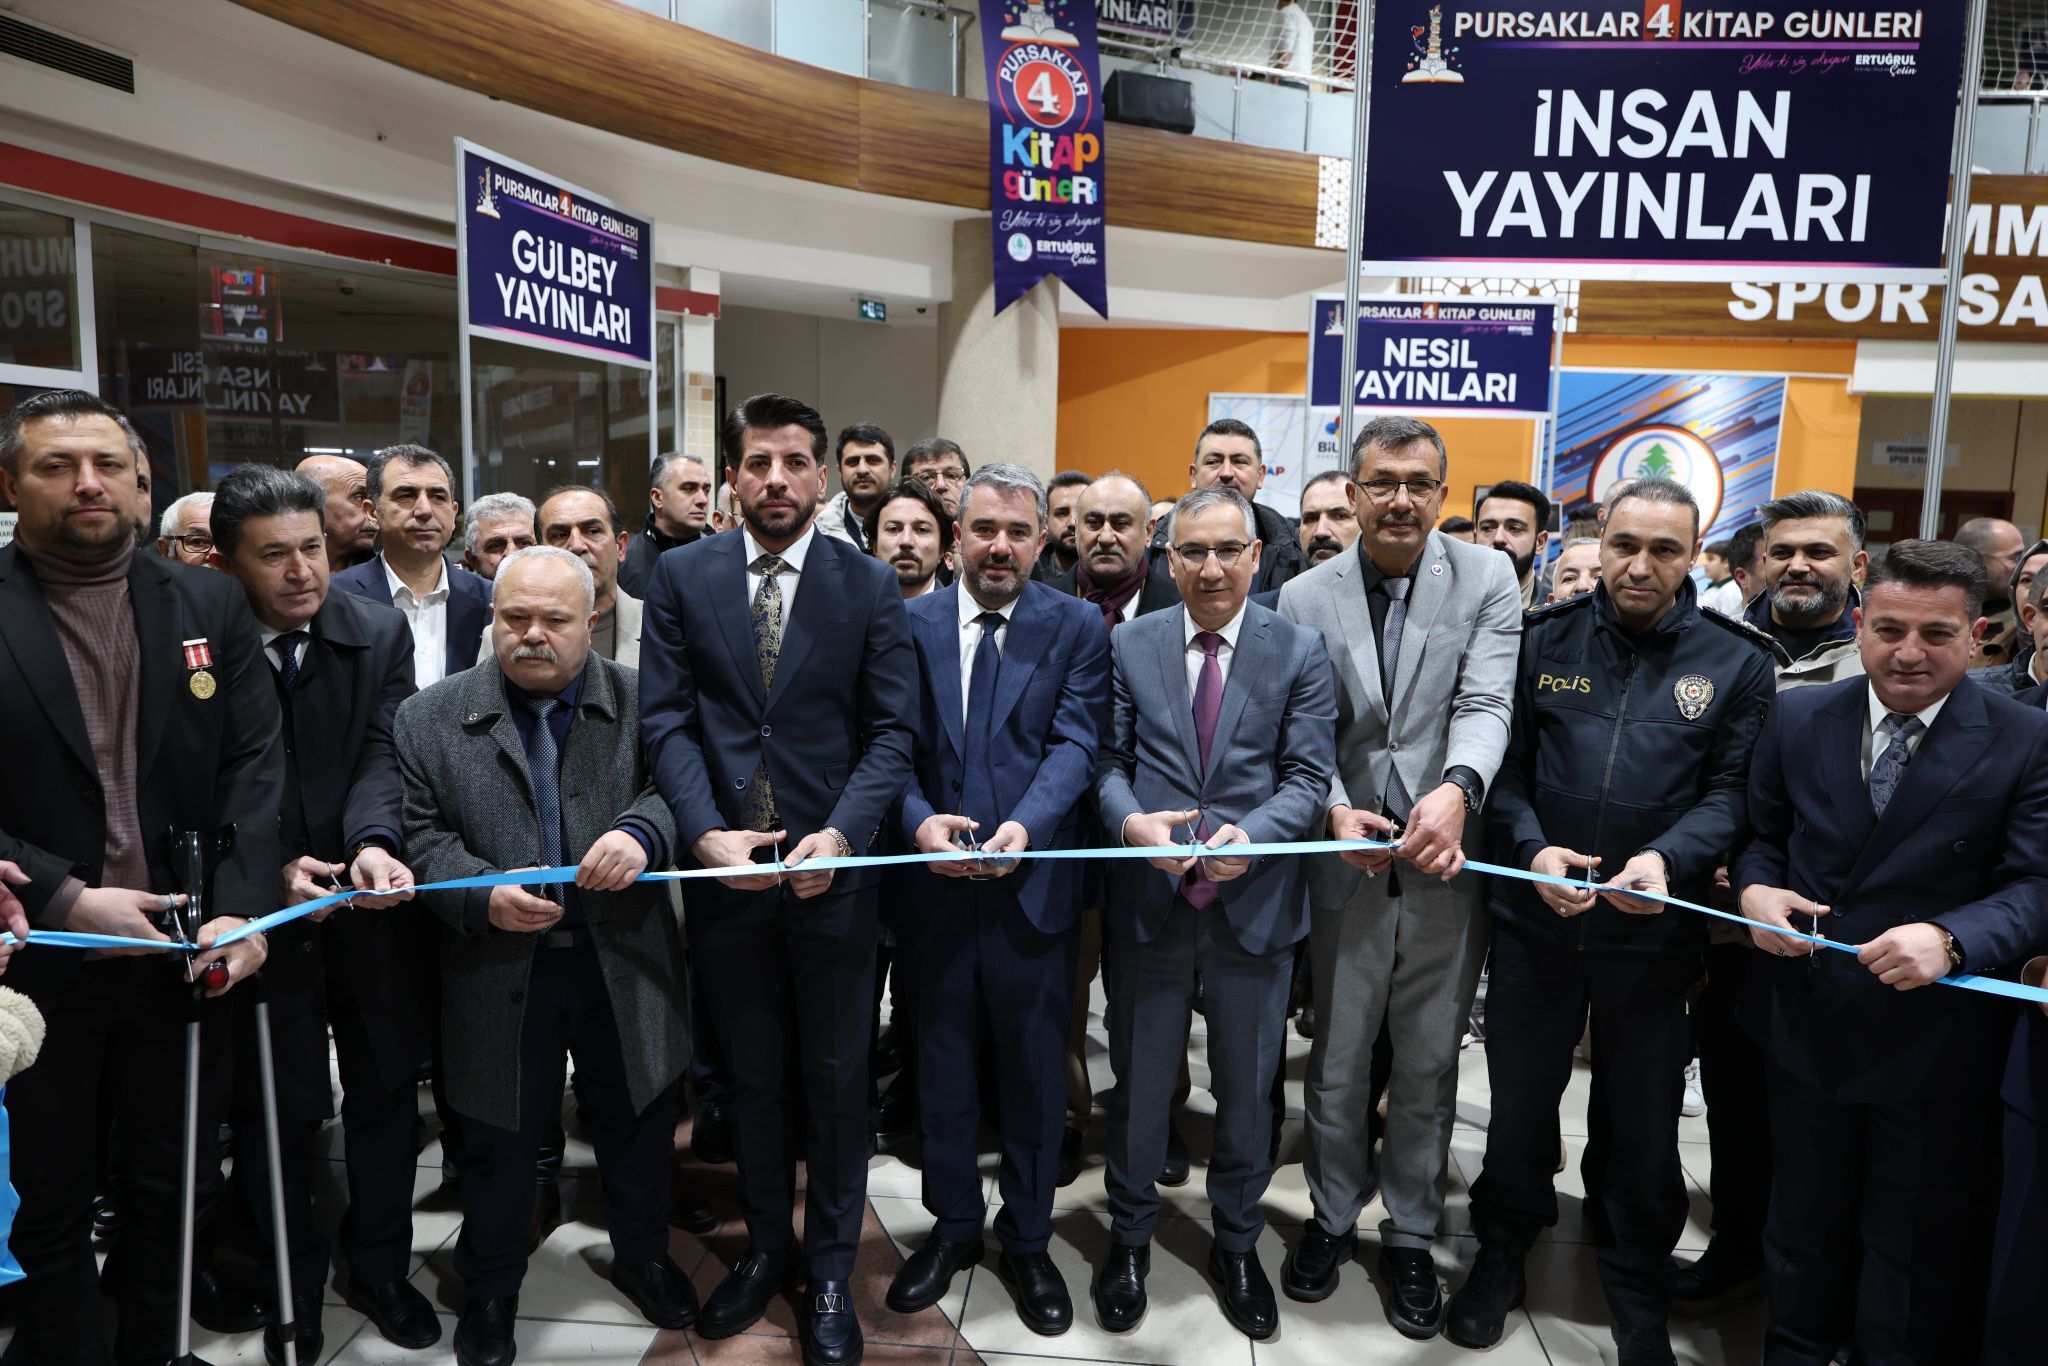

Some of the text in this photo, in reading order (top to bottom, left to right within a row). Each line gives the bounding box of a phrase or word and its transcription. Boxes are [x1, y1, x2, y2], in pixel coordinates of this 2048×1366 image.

[1095, 0, 1172, 29] INLARI
[1455, 11, 1640, 38] PURSAKLAR
[1684, 10, 1775, 38] KİTAP
[1784, 9, 1922, 39] GÜNLERİ
[1000, 44, 1088, 96] PURSAKLAR
[1855, 53, 1916, 66] ERTUĞRUL
[1889, 64, 1917, 77] Çetin
[1534, 88, 1791, 159] İNSAN
[494, 174, 559, 213] PURSAKLAR
[571, 203, 599, 226] KİTAP
[600, 214, 639, 241] GÜNLERİ
[1442, 171, 1871, 242] YAYINLARI
[1036, 239, 1096, 254] ERTUĞRUL
[512, 229, 617, 297] GÜLBEY
[494, 272, 632, 345] YAYINLARI
[1356, 306, 1422, 319] URSAKLAR
[1727, 281, 1930, 324] SPOR
[1384, 337, 1479, 369] NESİL
[1538, 673, 1591, 693] POLİS
